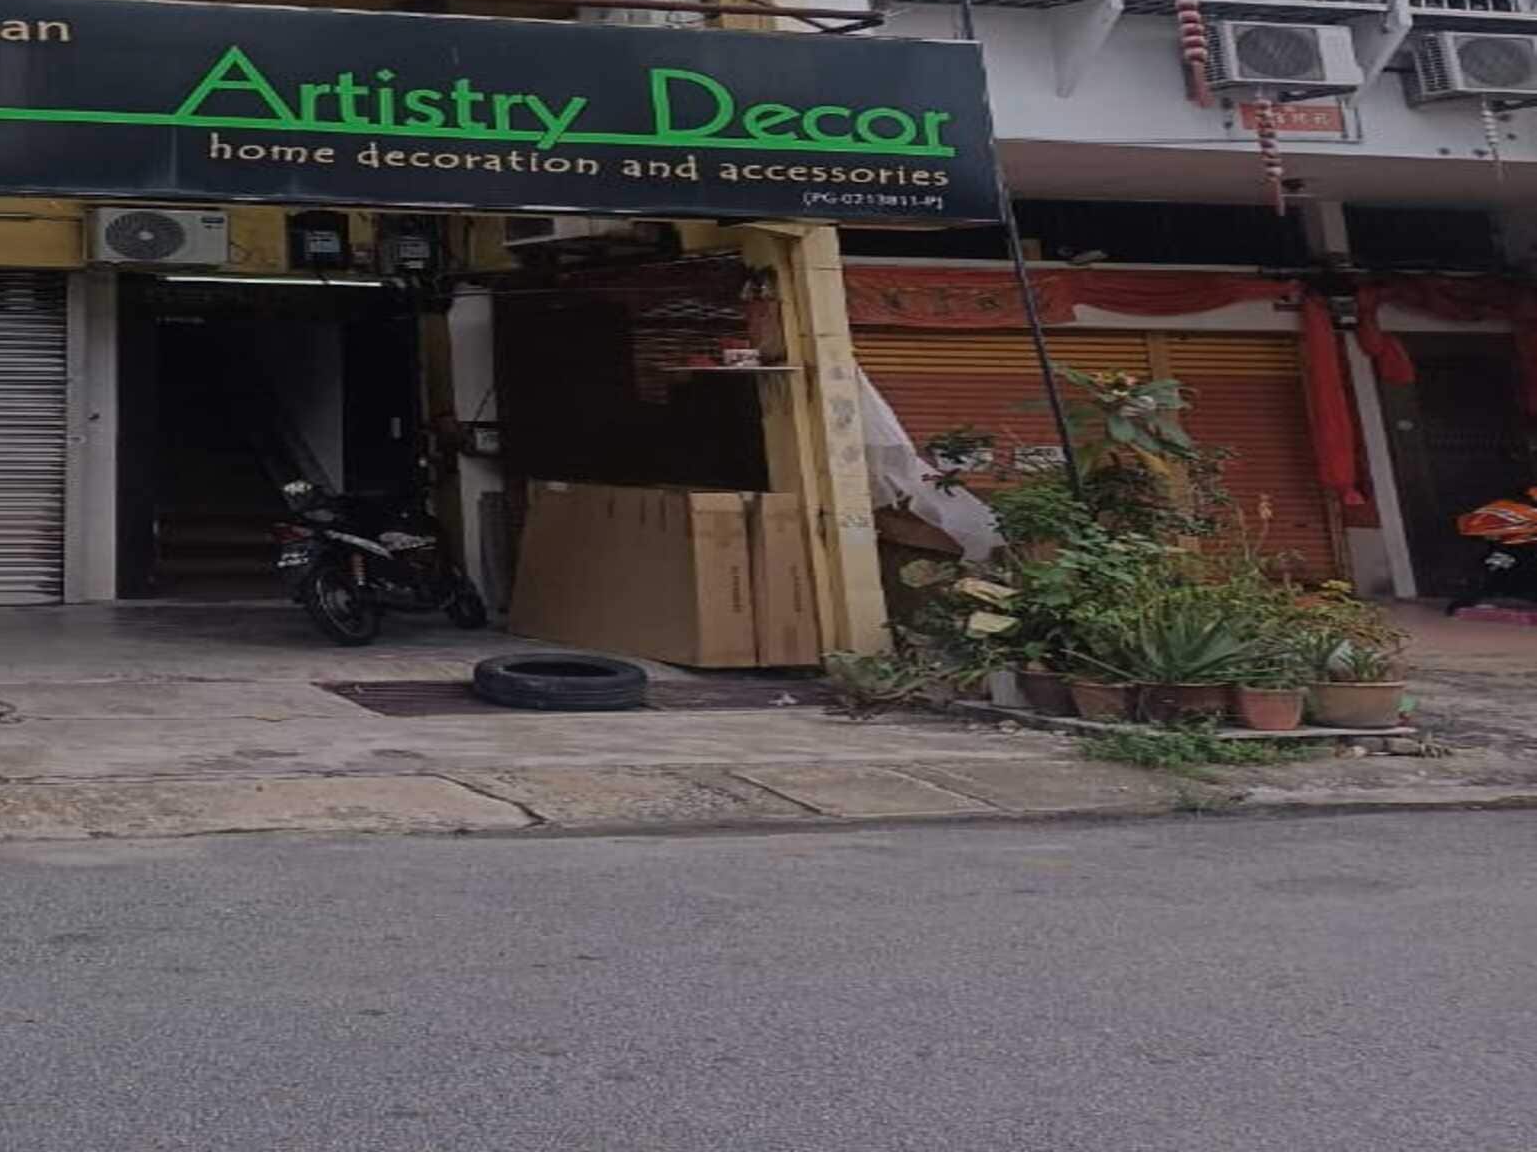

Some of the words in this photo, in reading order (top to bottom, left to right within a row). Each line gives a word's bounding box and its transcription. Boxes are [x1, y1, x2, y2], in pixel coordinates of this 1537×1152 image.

[173, 46, 588, 150] Artistry
[650, 67, 953, 152] Decor
[209, 132, 335, 164] home
[357, 141, 599, 176] decoration
[622, 154, 699, 182] and
[719, 162, 949, 187] accessories
